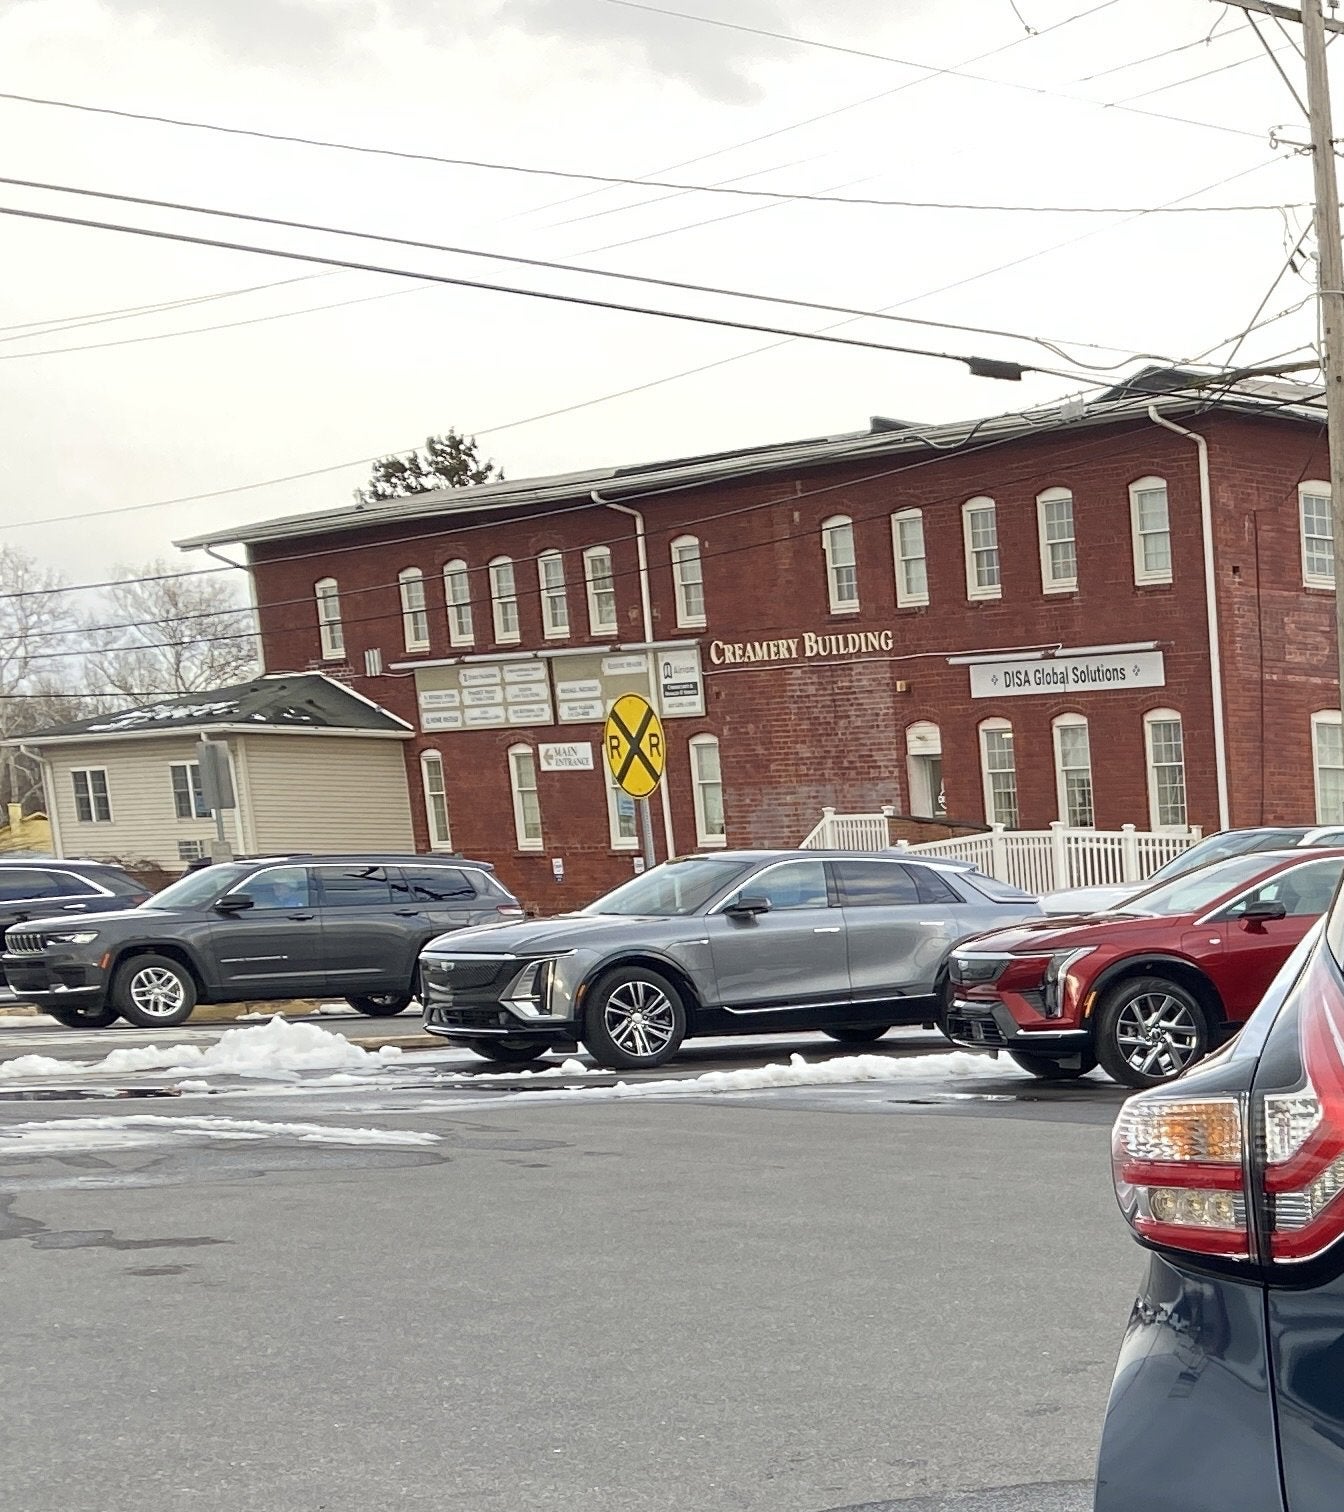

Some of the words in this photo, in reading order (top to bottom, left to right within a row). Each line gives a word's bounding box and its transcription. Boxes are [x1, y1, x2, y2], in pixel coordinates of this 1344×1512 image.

[710, 638, 800, 665] CREAMERY
[802, 630, 893, 657] BUILDING
[1004, 670, 1031, 688] DISA
[1034, 666, 1069, 686] Global
[1072, 663, 1126, 684] Solutions
[553, 746, 578, 757] MAIN
[609, 735, 622, 760] R
[648, 733, 662, 758] R
[555, 757, 591, 767] ENTRANCE
